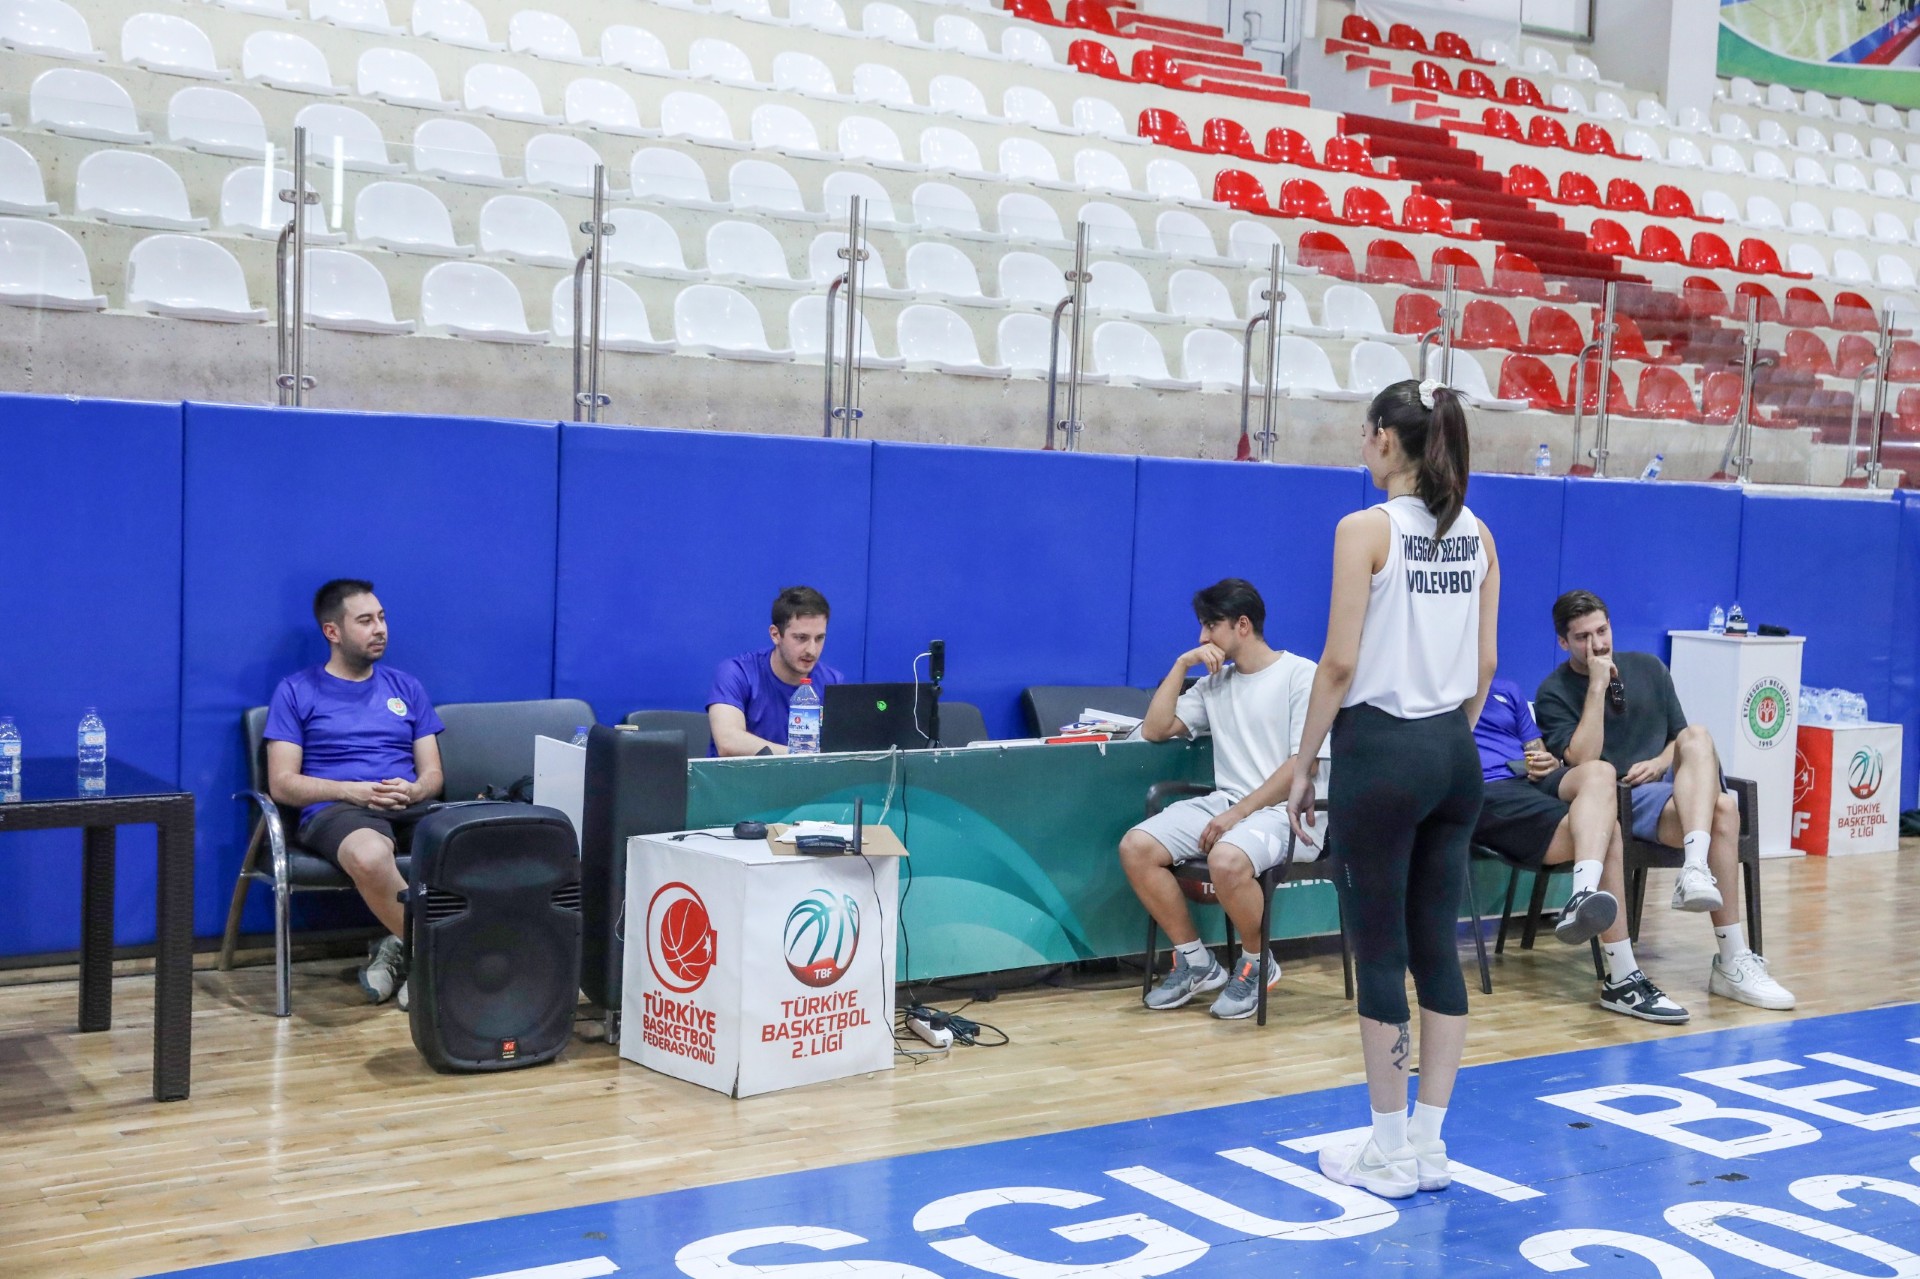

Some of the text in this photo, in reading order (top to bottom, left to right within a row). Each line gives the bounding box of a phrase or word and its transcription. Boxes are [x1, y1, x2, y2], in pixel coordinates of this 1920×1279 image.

[1407, 569, 1475, 594] VOLEYBO
[1838, 814, 1888, 828] BASKETBOL
[1846, 802, 1881, 816] TÜRKİYE
[814, 968, 833, 980] TBF
[643, 990, 717, 1034] TÜRKİYE
[781, 989, 858, 1018] TÜRKİYE
[643, 1015, 717, 1051] BASKETBOL
[761, 1008, 871, 1042] BASKETBOL
[643, 1032, 716, 1065] FEDERASYONU
[792, 1029, 843, 1059] 2. LİGİ
